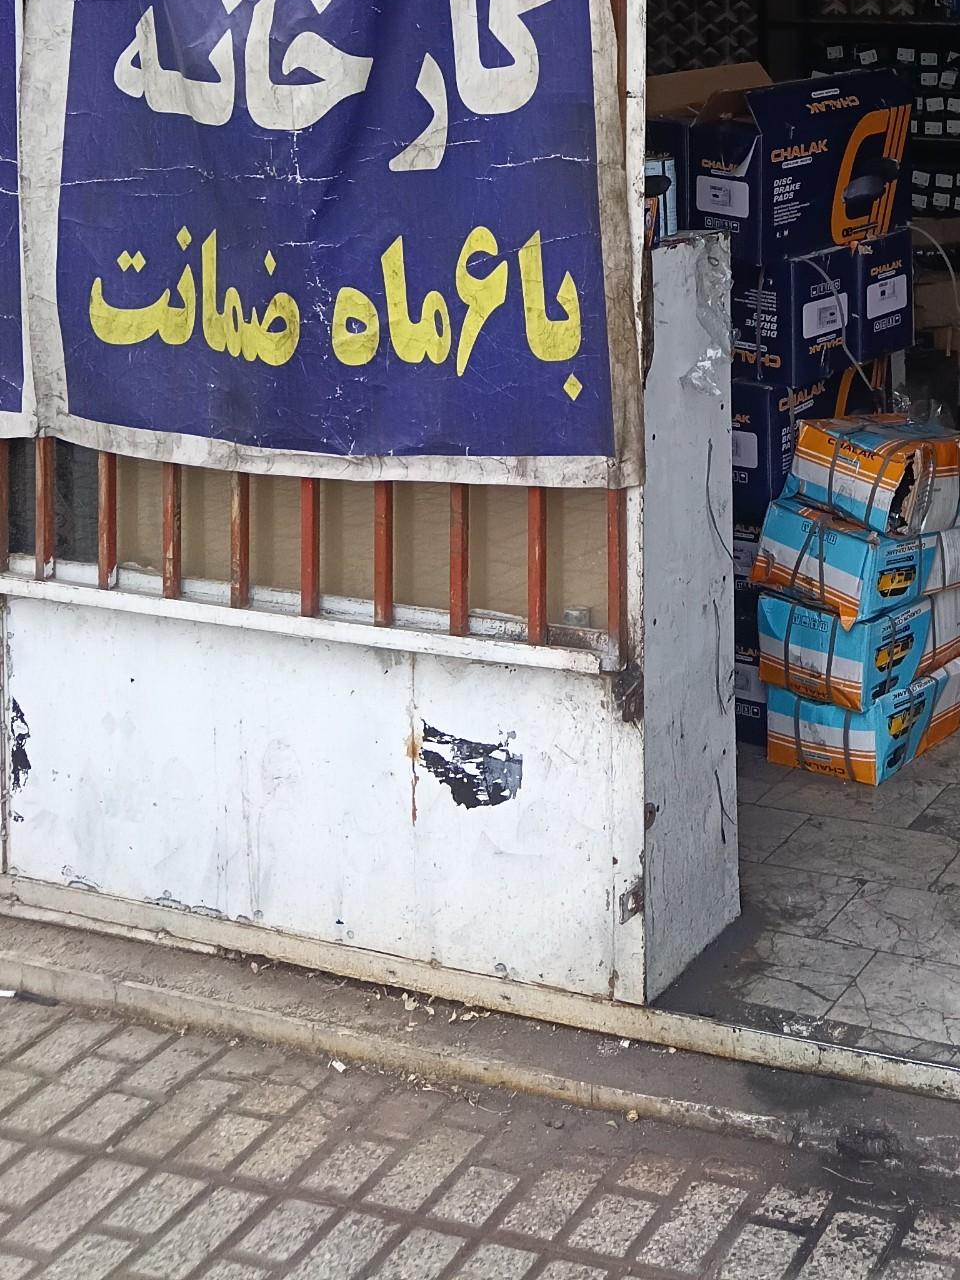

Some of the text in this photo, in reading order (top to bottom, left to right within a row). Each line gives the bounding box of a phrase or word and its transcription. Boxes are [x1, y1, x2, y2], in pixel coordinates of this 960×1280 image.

[809, 95, 860, 115] CHALAK
[771, 138, 829, 163] CHALAK
[773, 176, 793, 187] DISC
[773, 182, 802, 195] BRAKE
[773, 191, 795, 203] PADS
[870, 259, 902, 276] CHALAK
[89, 225, 584, 402] با ۶ ماه ضمانت
